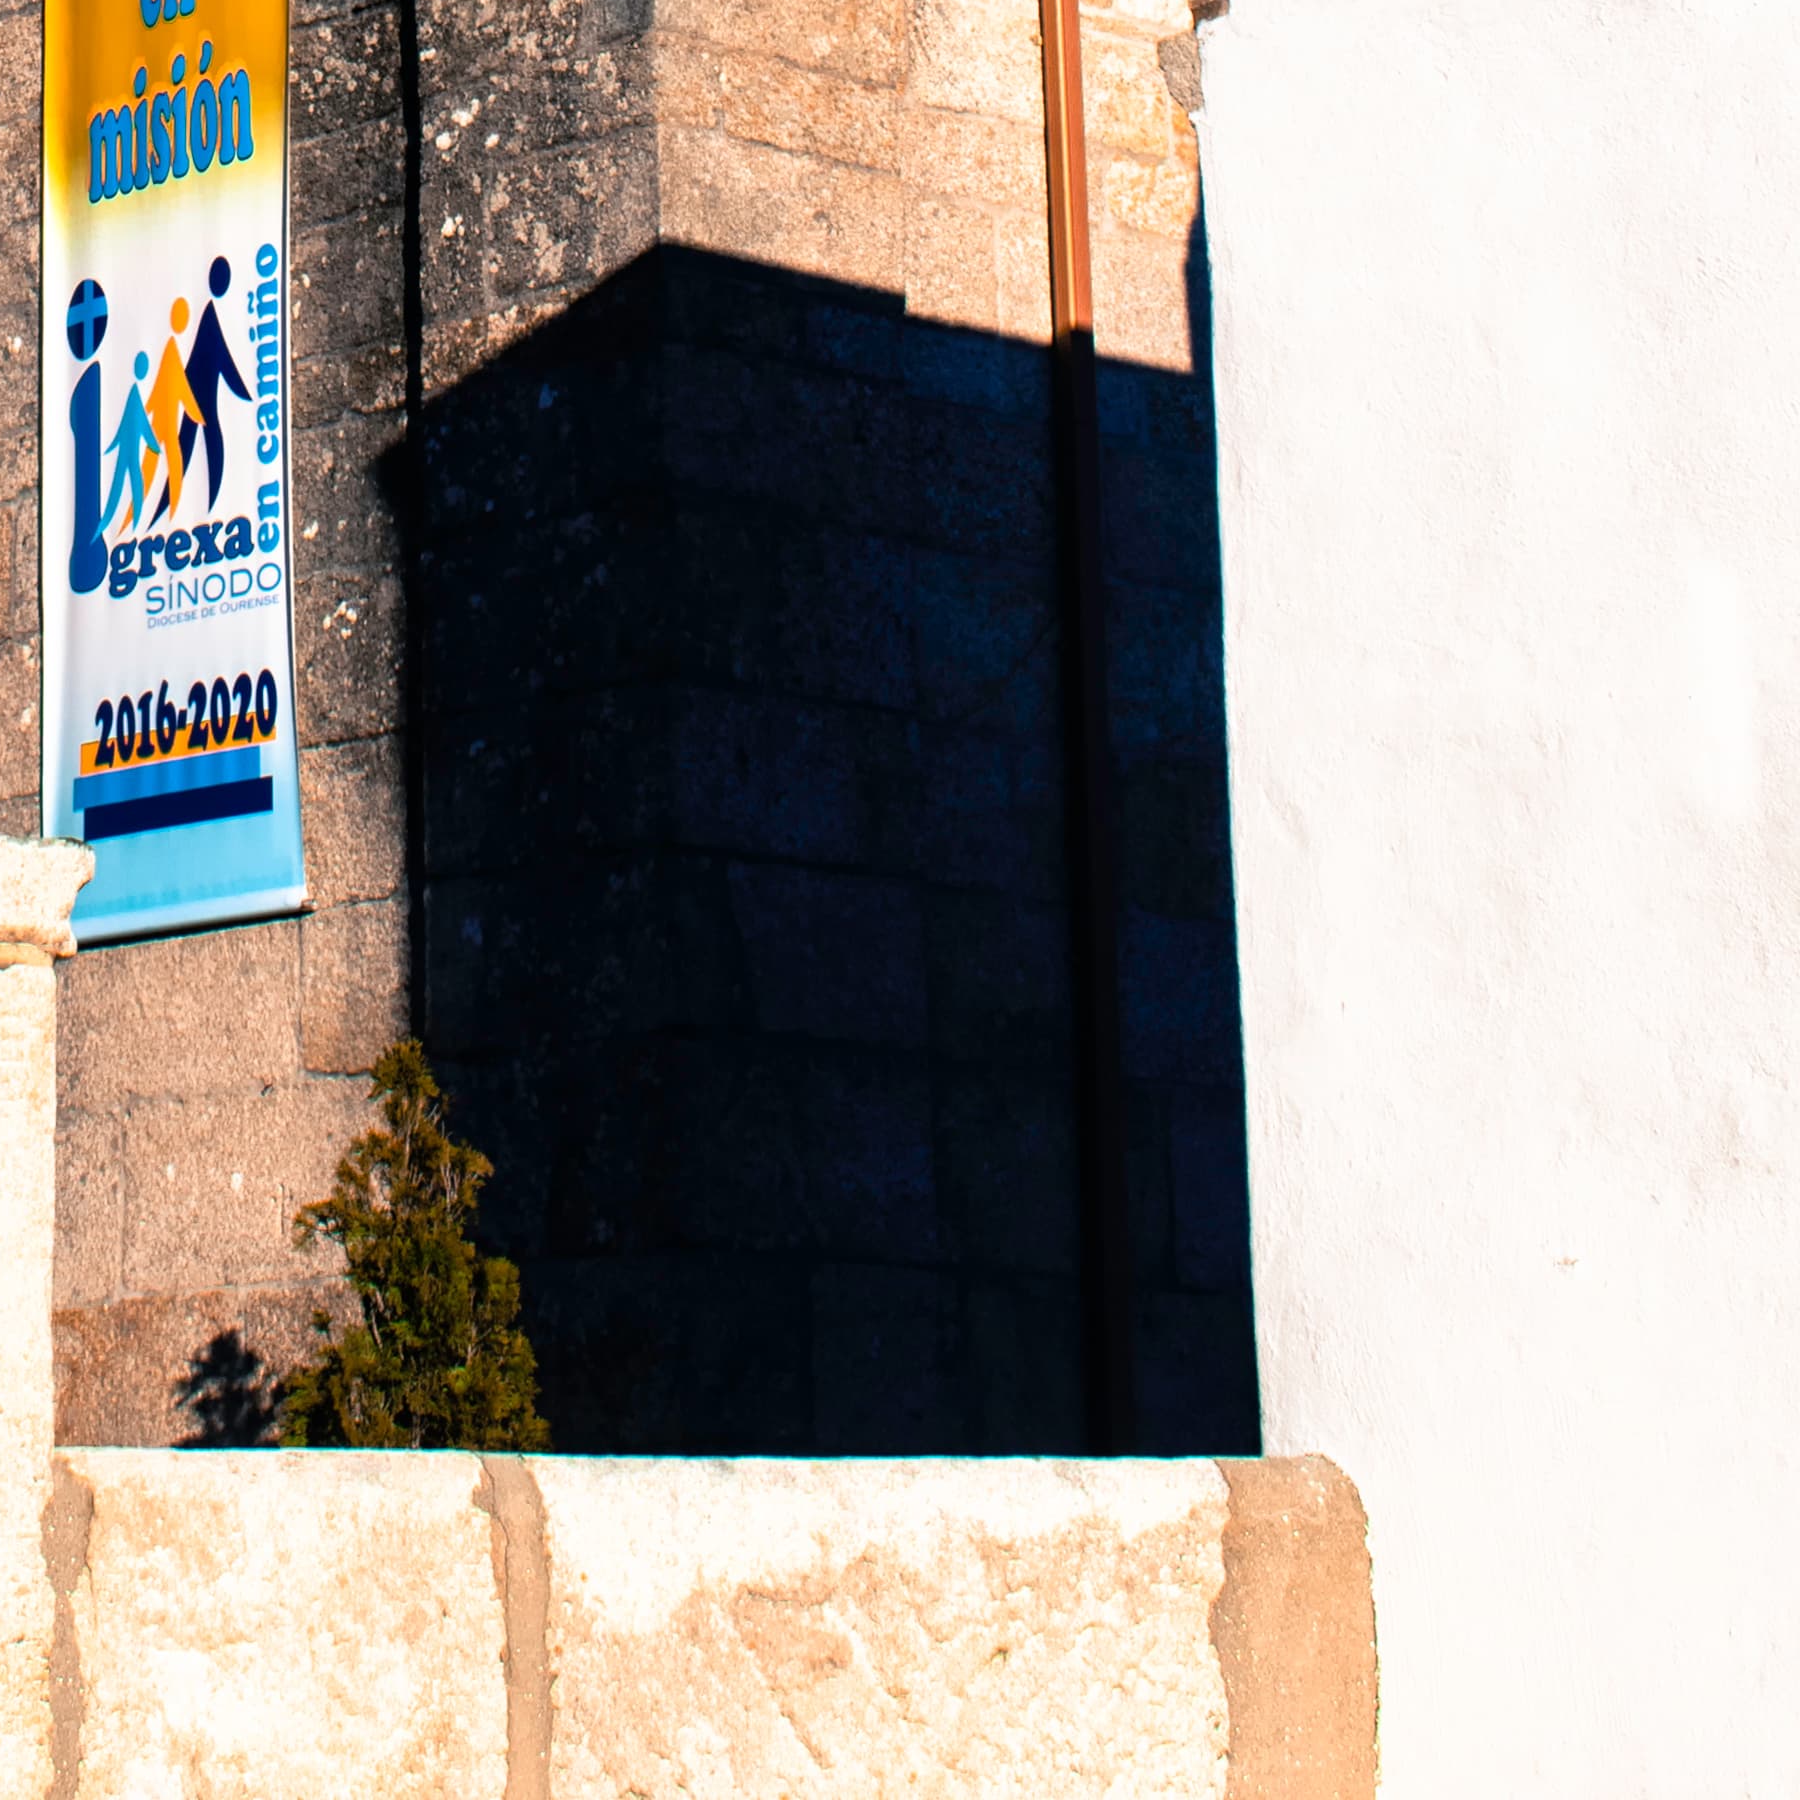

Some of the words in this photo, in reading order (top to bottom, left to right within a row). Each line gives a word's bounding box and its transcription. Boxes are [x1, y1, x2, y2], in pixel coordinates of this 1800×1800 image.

[86, 40, 254, 203] misión
[247, 242, 279, 465] camiño
[256, 479, 280, 553] en
[146, 563, 282, 616] SÍNODO
[200, 606, 217, 619] DE
[94, 667, 278, 769] 2016-2020
